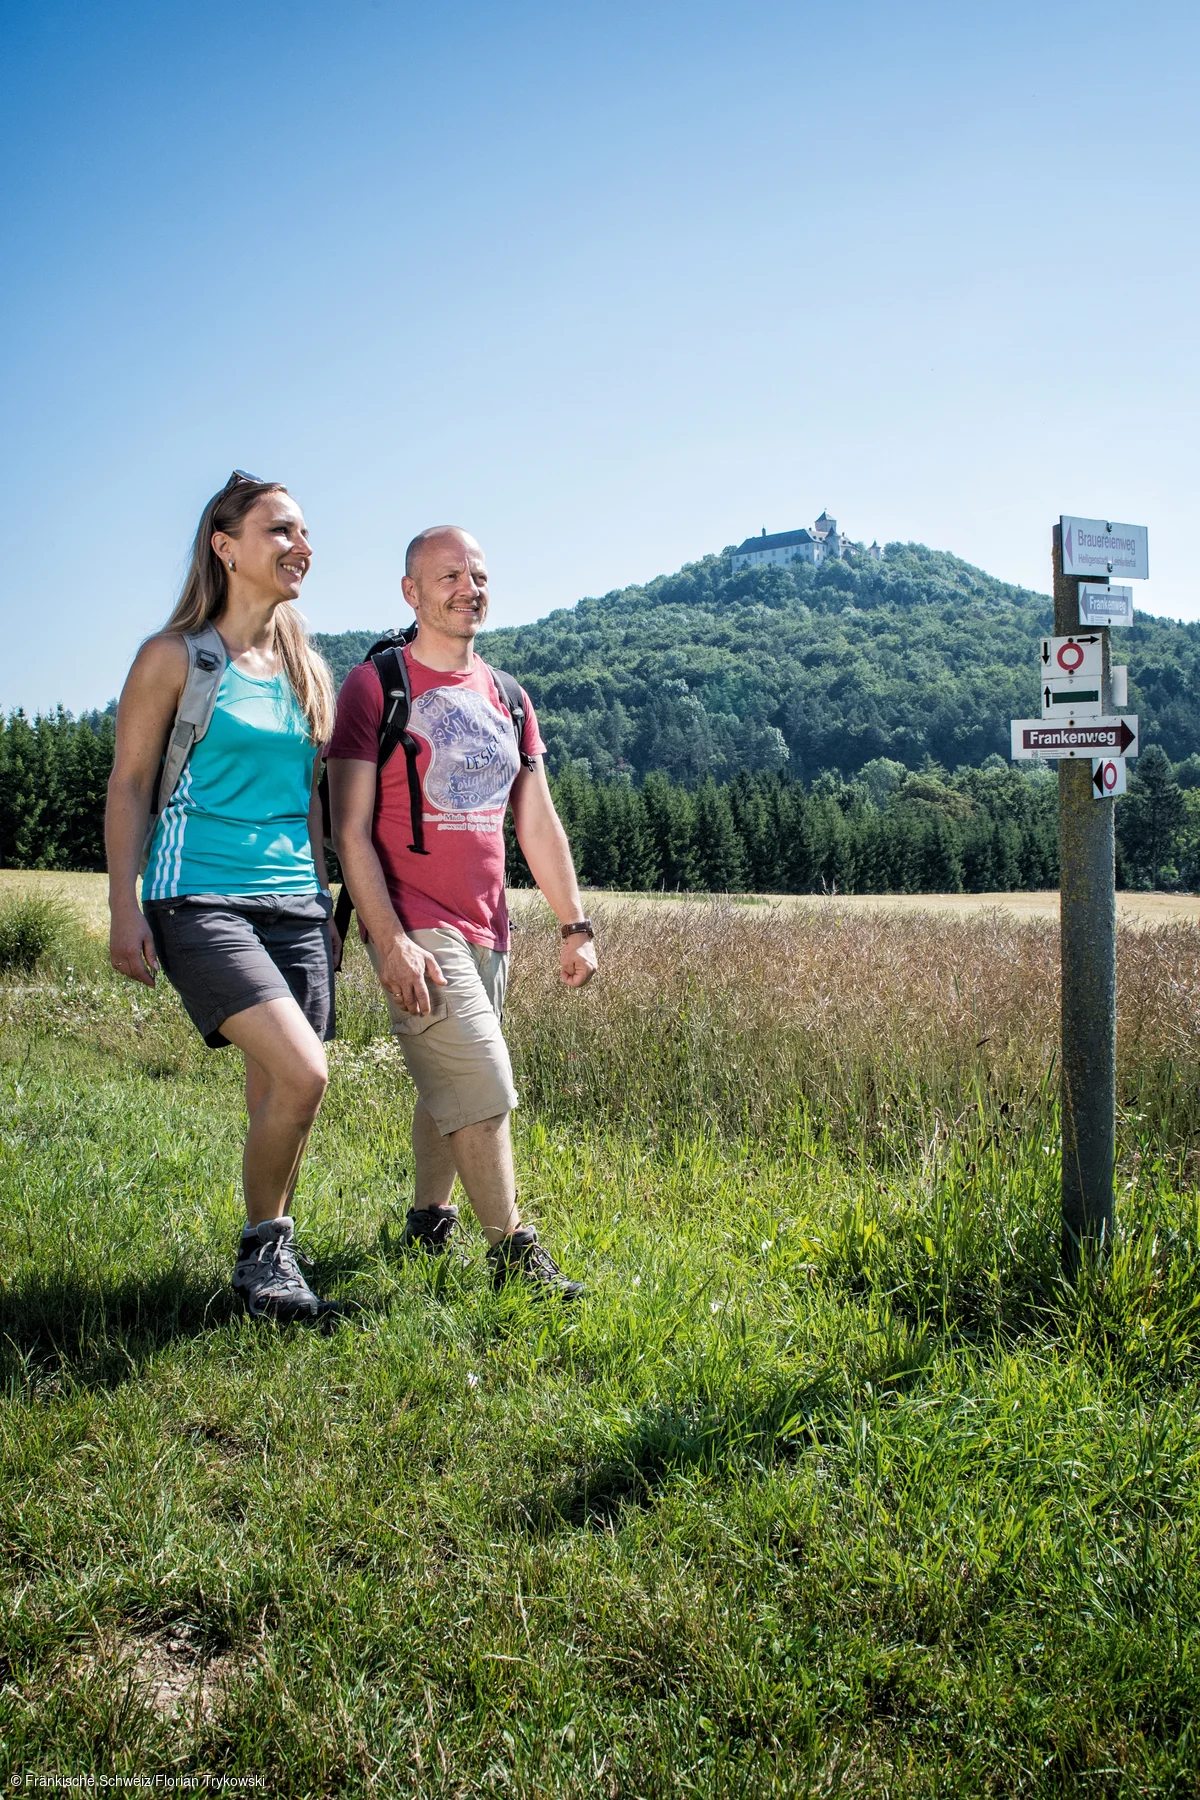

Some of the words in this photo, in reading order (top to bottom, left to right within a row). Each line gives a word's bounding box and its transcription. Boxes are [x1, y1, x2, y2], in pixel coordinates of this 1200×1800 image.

[1078, 529, 1135, 556] Brauereienweg
[1089, 595, 1127, 615] Frankenweg
[1029, 731, 1116, 746] Frankenweg
